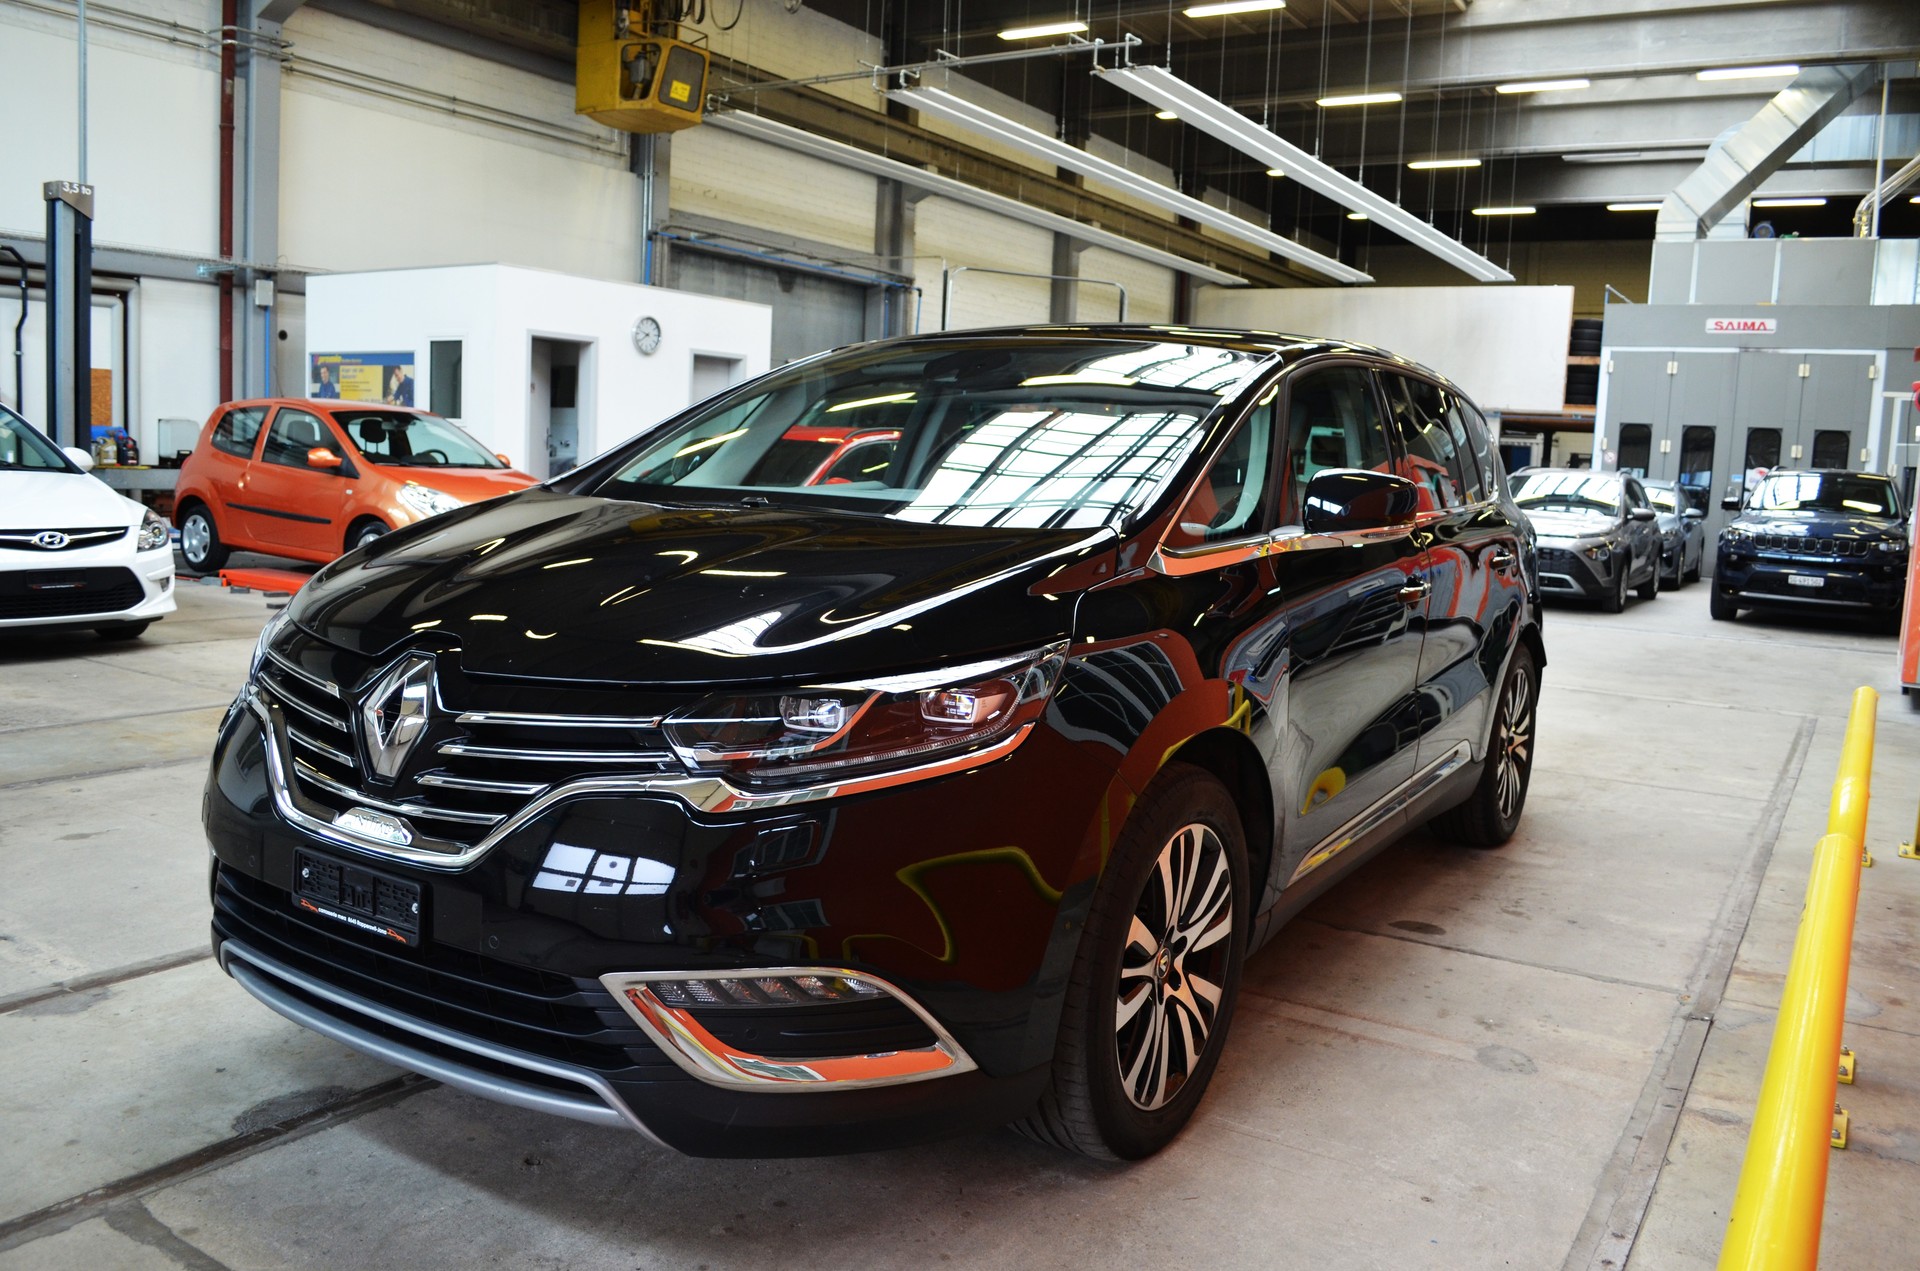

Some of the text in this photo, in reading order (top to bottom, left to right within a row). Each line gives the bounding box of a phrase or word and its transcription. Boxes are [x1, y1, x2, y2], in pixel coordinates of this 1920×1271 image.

[62, 181, 92, 195] 3,5 to
[1714, 320, 1768, 331] SAIMA
